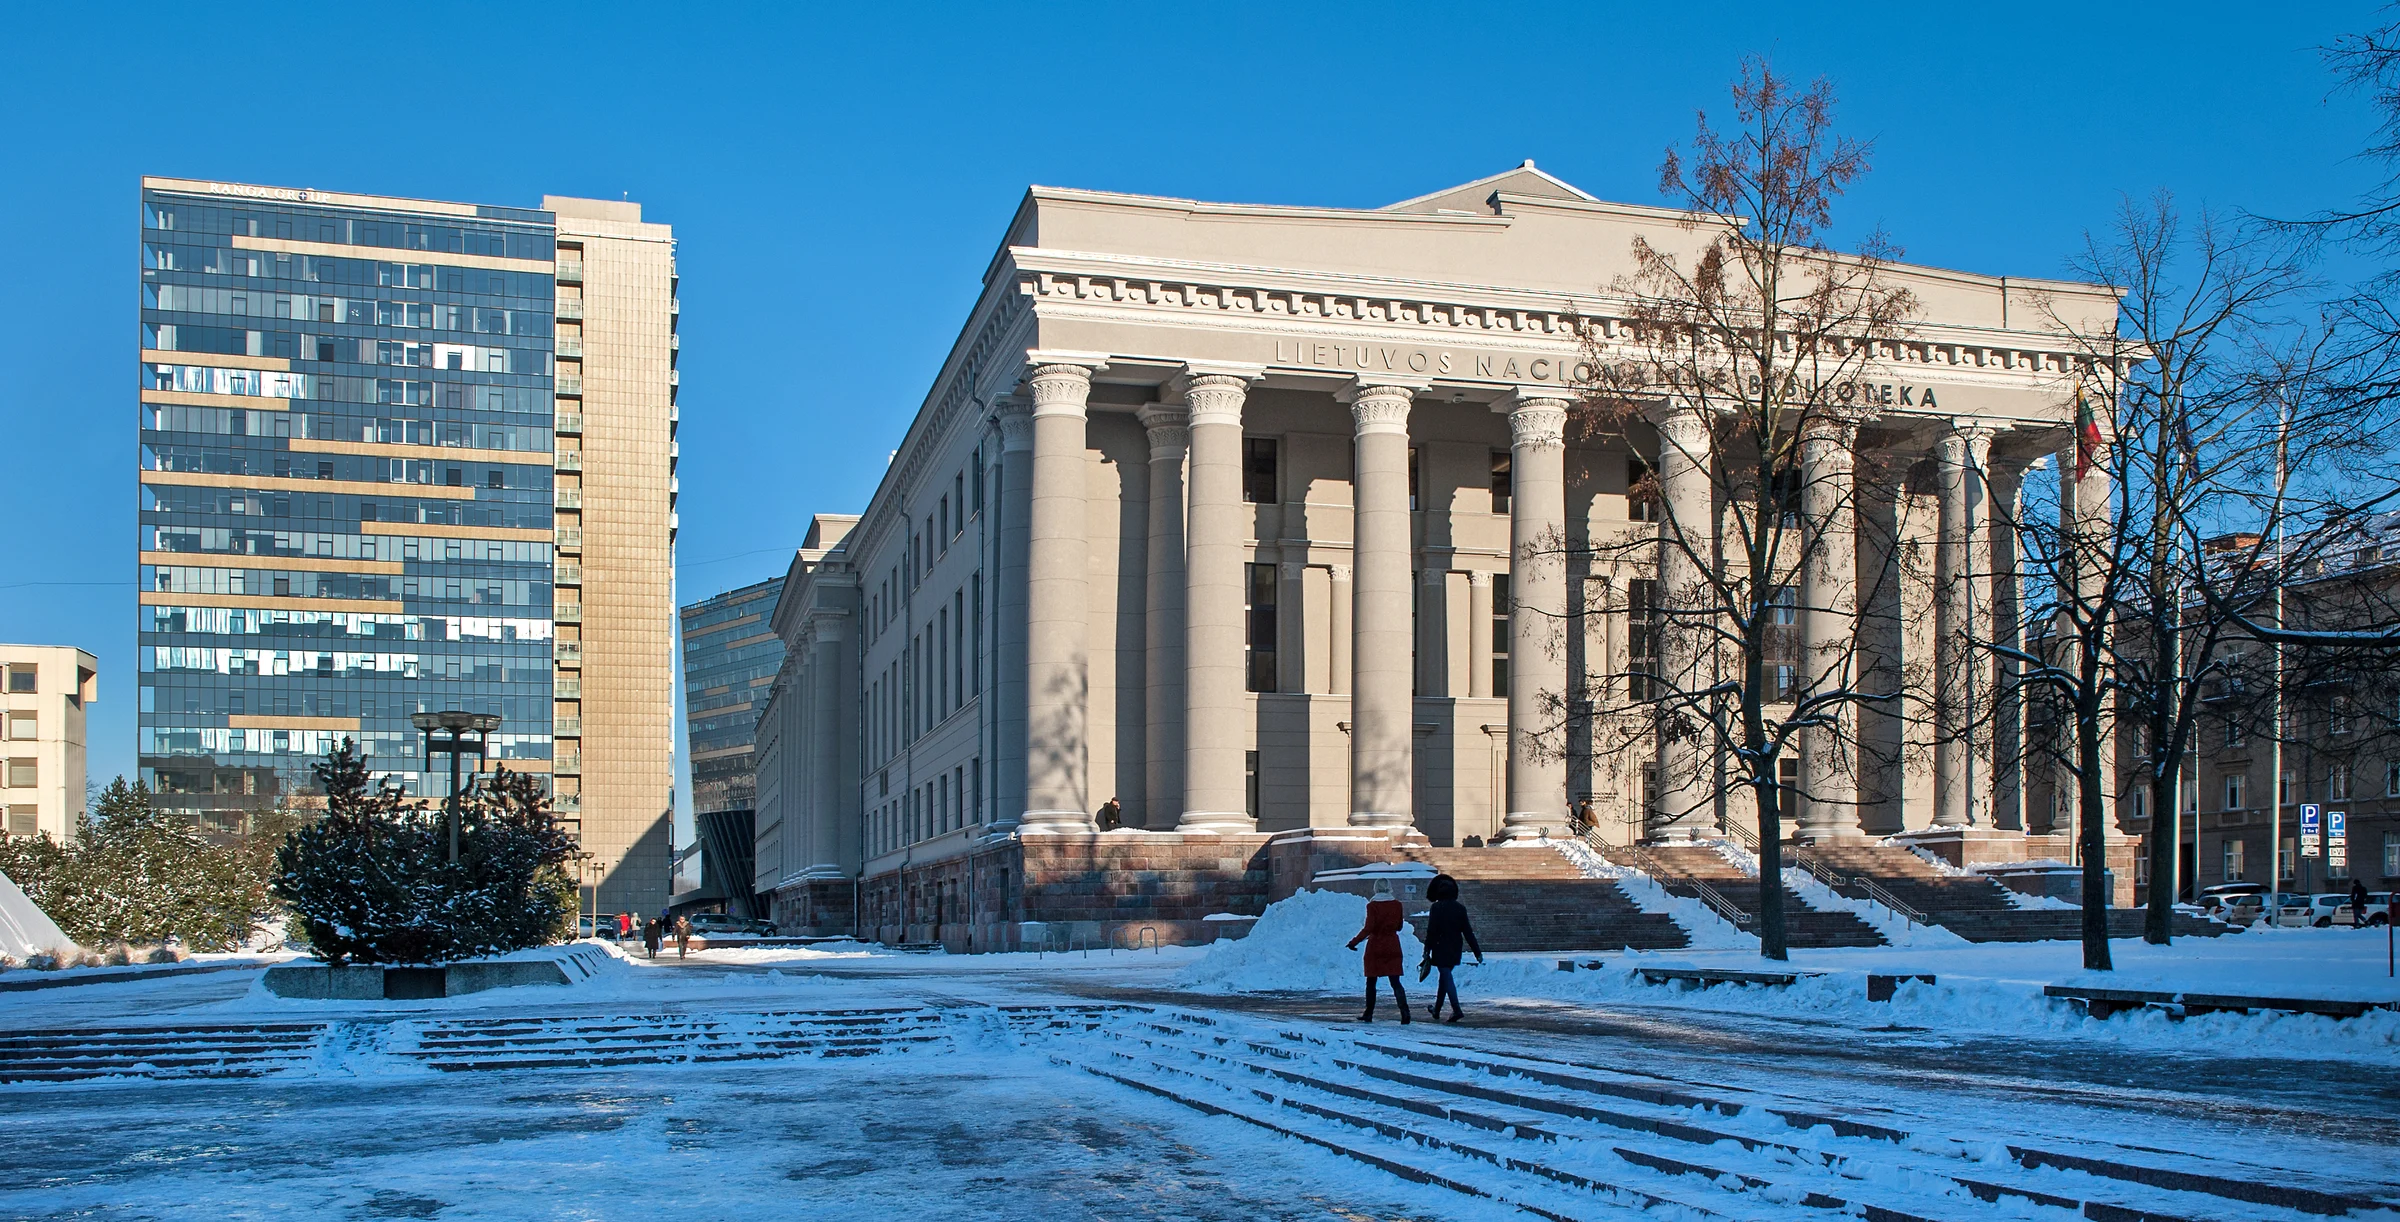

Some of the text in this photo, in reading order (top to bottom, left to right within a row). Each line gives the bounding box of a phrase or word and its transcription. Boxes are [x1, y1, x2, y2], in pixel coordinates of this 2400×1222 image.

[210, 183, 268, 197] RANGA
[1276, 340, 1452, 374] LIETUVOS
[2305, 806, 2316, 823] P
[2332, 814, 2342, 828] P
